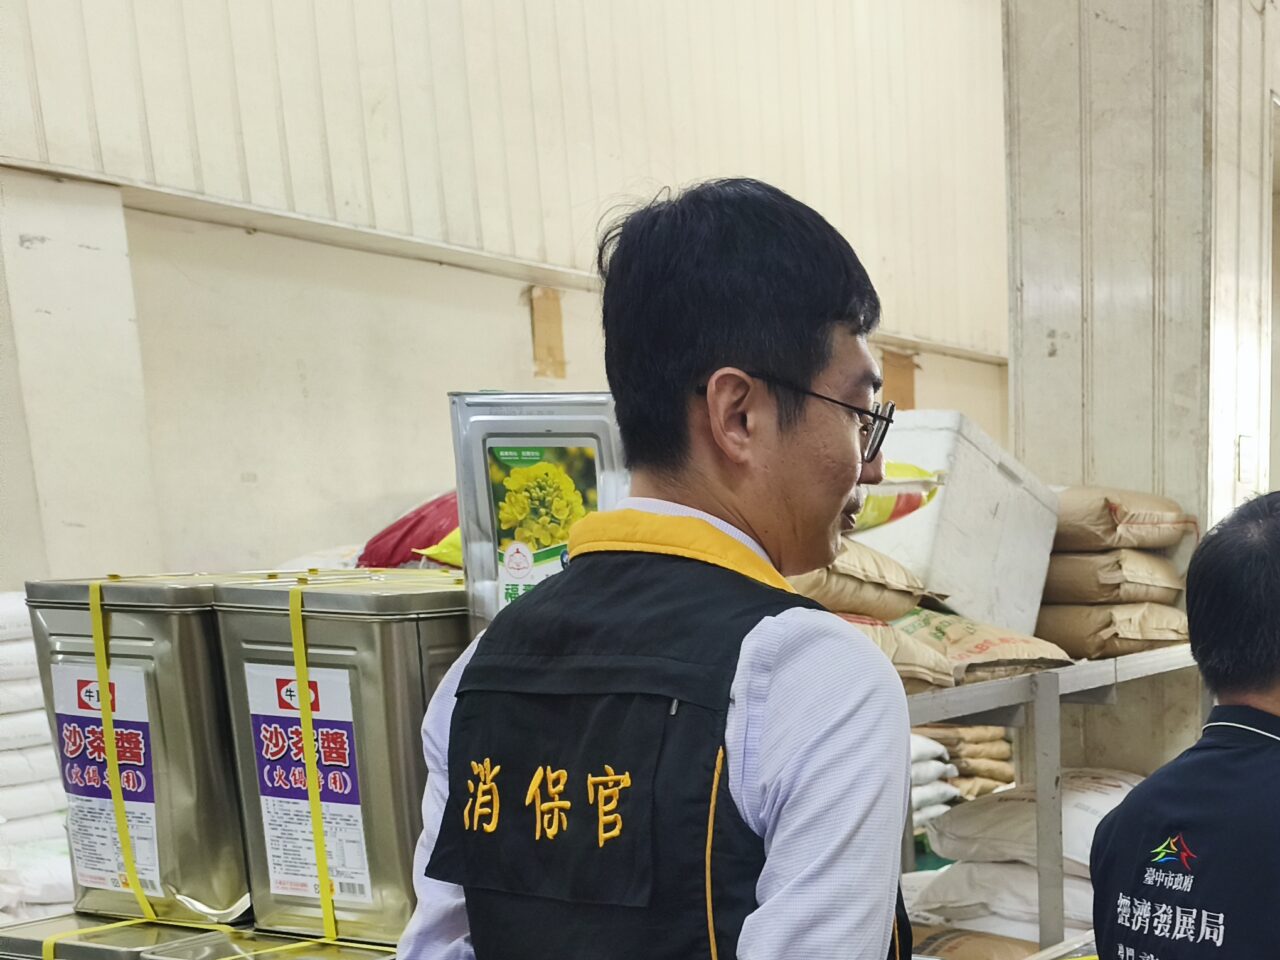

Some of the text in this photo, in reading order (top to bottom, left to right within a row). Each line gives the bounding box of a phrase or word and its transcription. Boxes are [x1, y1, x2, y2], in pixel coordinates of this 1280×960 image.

[463, 757, 632, 848] 消保官
[1143, 867, 1195, 892] 臺中市政府
[1117, 892, 1225, 947] 經濟發展局
